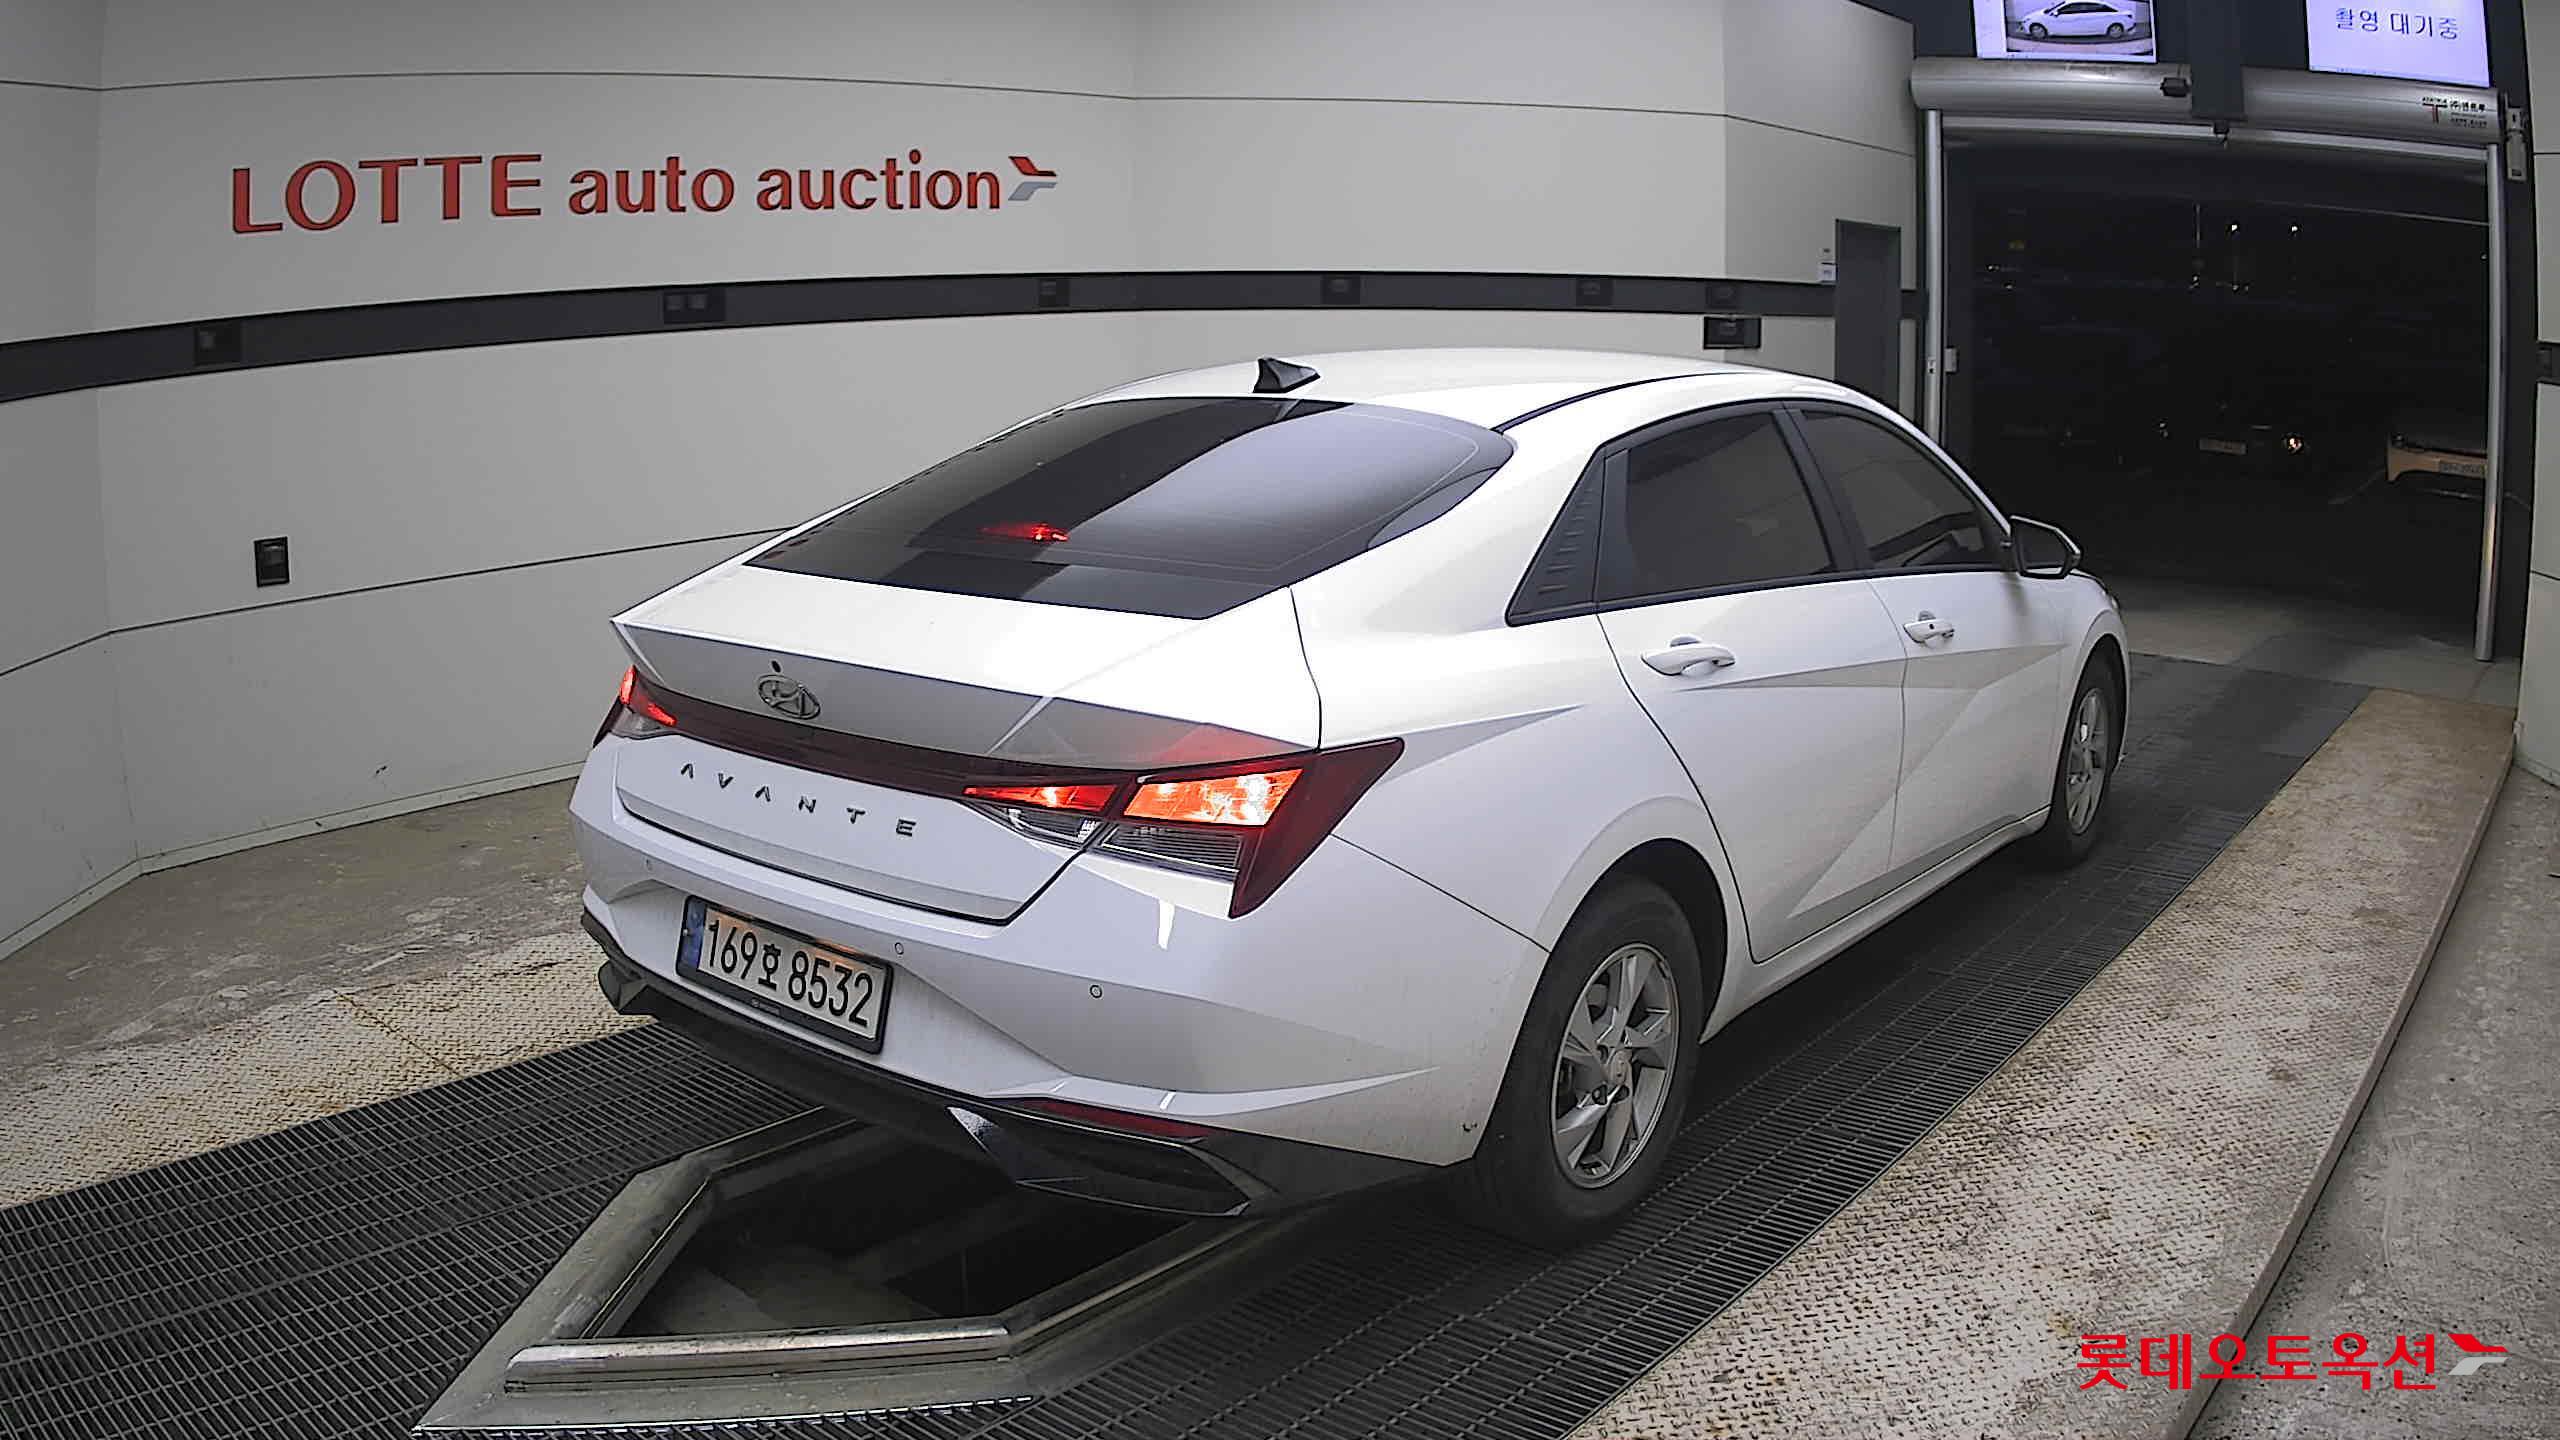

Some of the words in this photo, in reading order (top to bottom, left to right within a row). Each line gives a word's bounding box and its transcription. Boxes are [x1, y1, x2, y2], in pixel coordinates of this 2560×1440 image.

[2389, 12, 2458, 40] 대기중
[232, 153, 542, 234] LOTTE
[568, 155, 736, 215] auto
[756, 148, 1001, 211] auction
[679, 761, 918, 838] AVANTE
